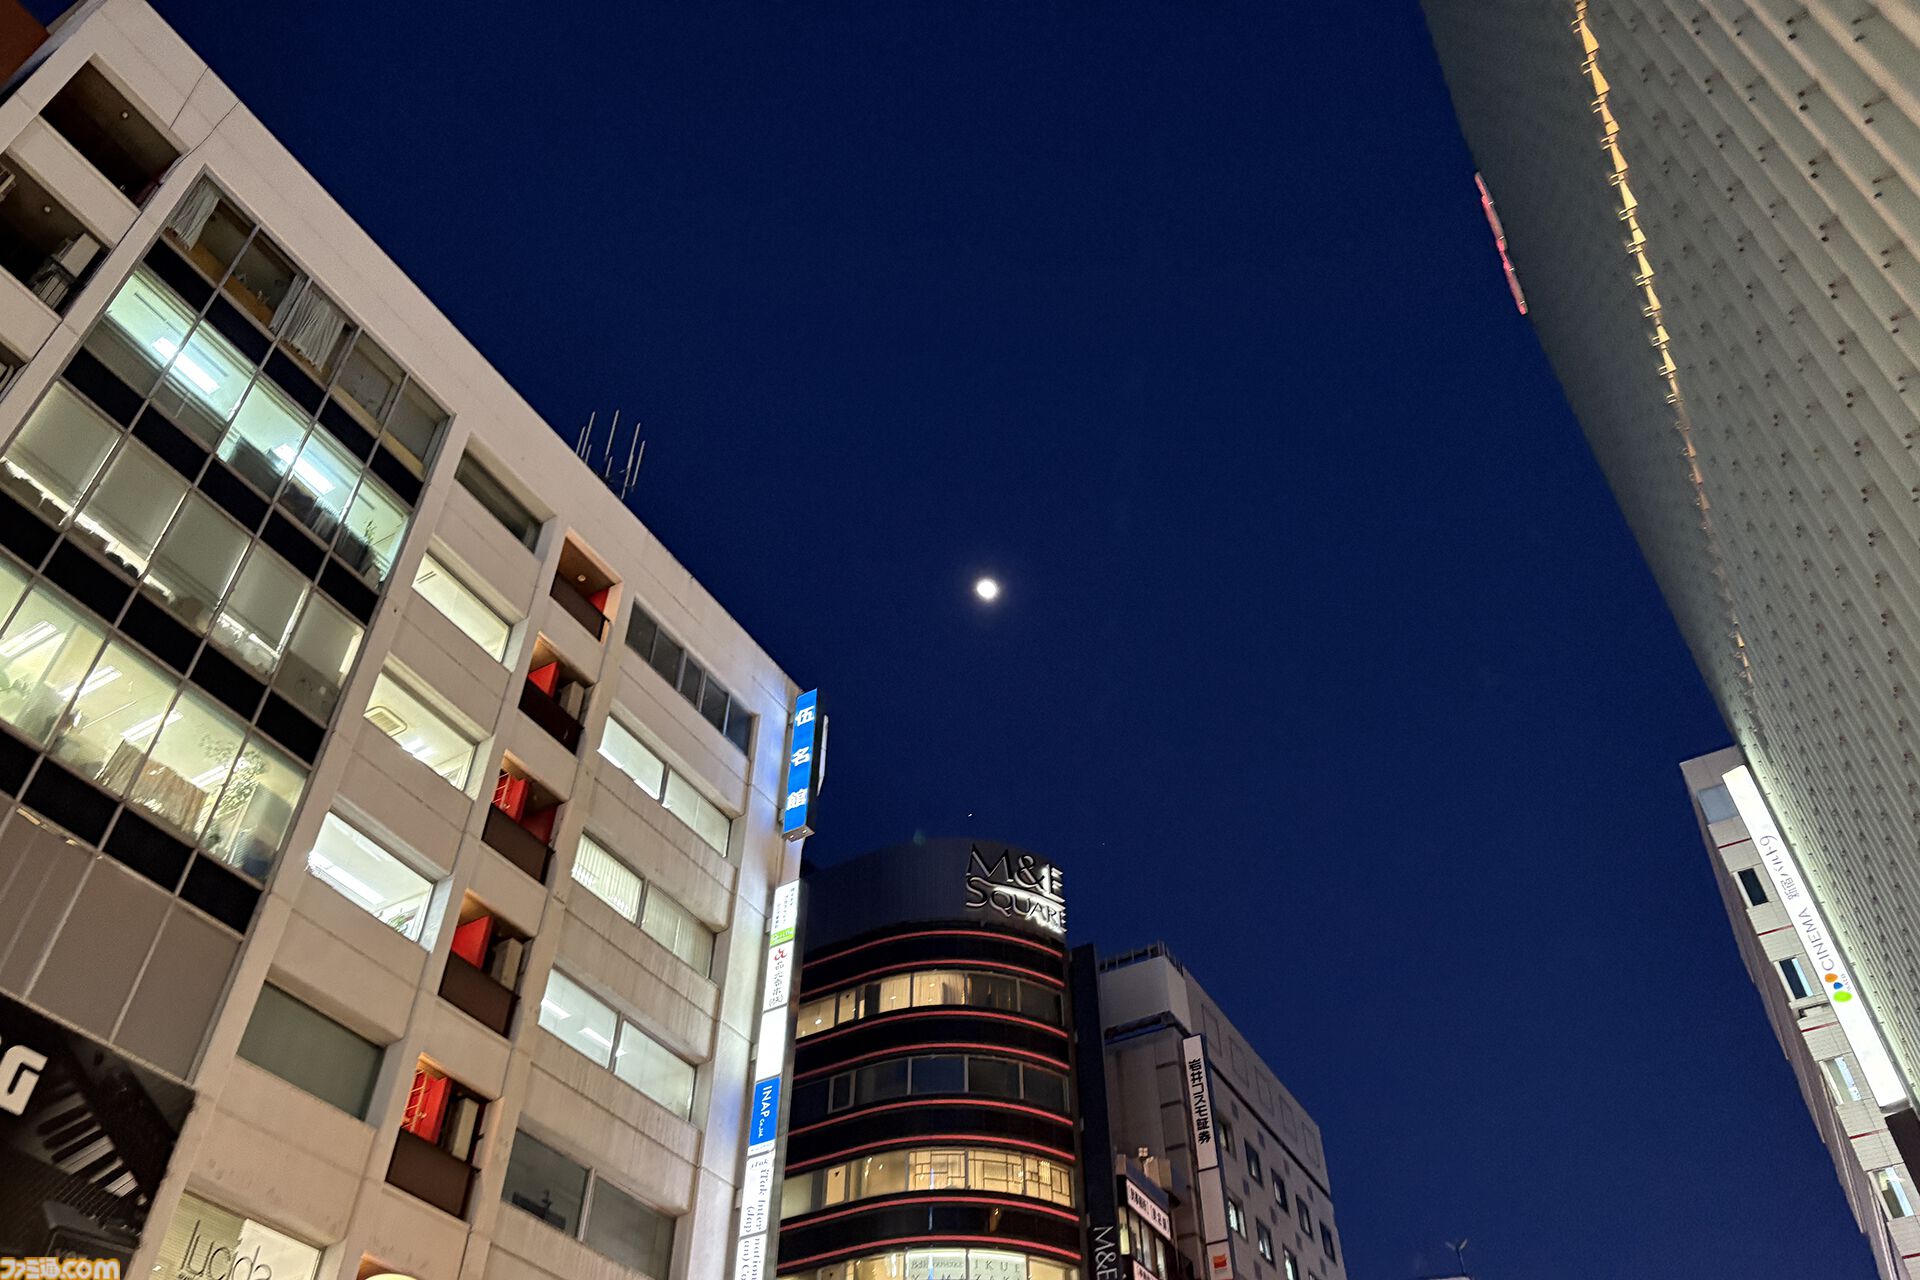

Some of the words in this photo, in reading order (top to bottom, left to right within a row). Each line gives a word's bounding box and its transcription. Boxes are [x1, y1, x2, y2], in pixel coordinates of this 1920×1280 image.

[787, 705, 815, 811] 伍名館
[966, 843, 1063, 902] M&E
[966, 876, 1067, 934] SQUARE
[1798, 907, 1834, 971] CINEMA
[759, 1085, 773, 1118] INAP
